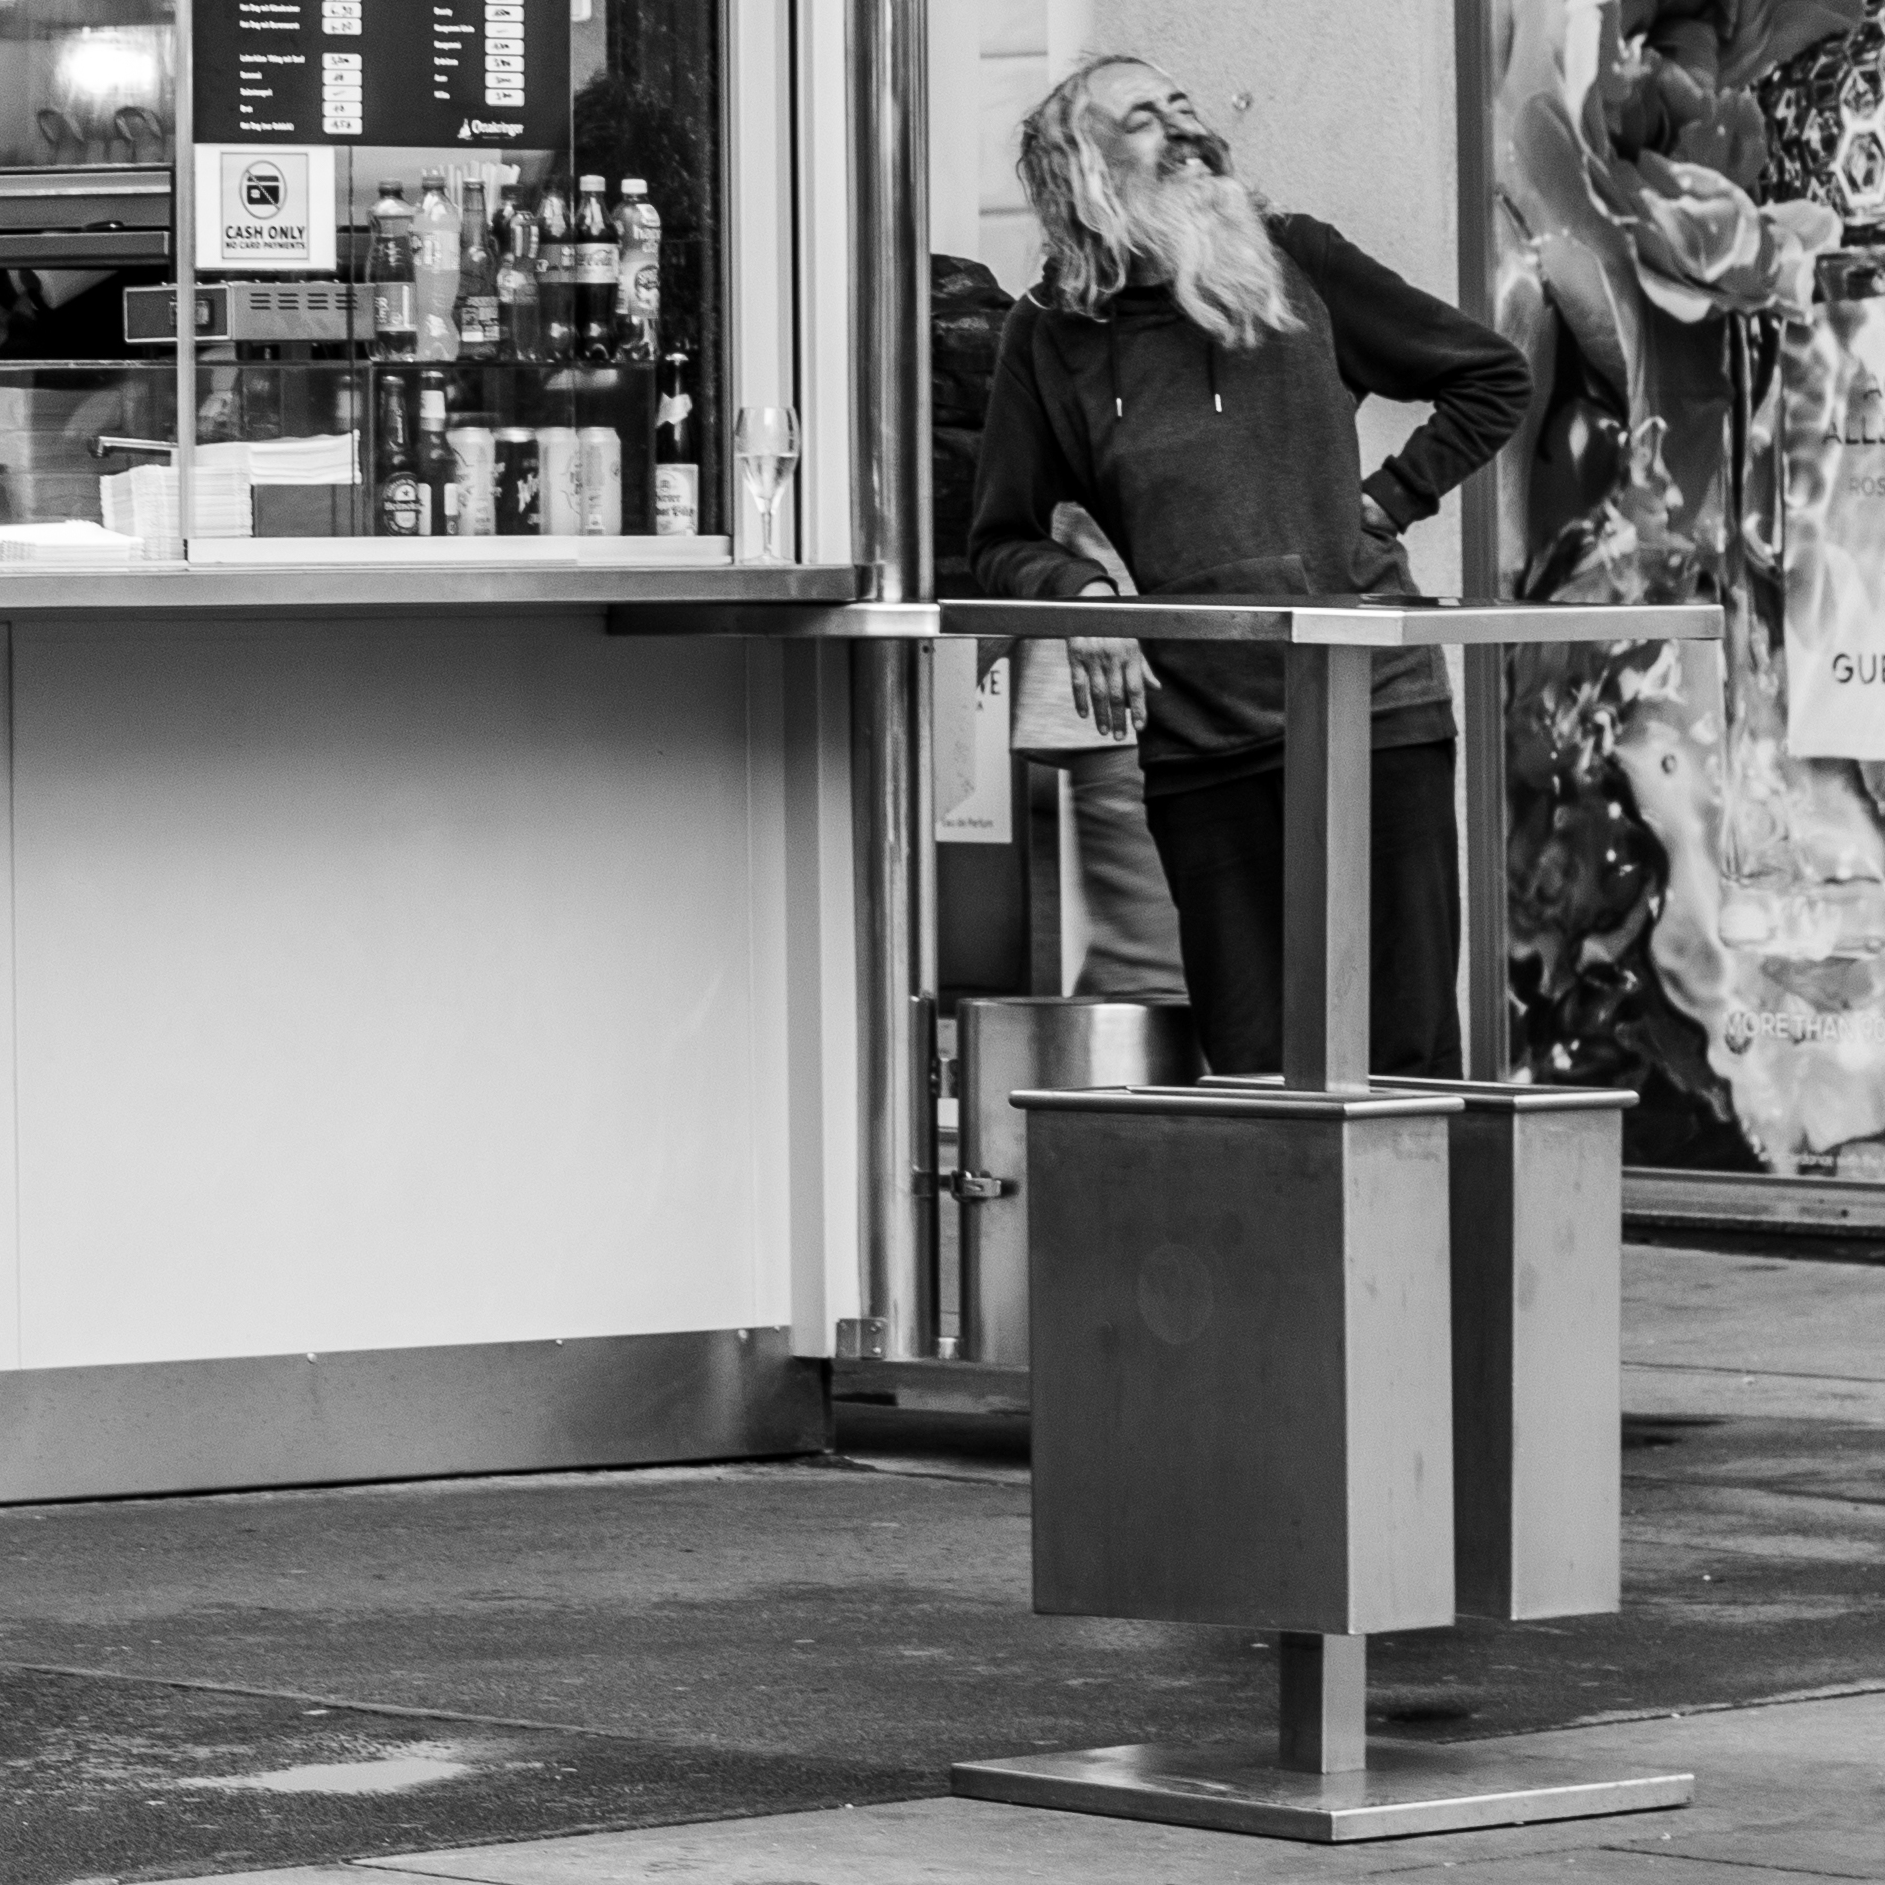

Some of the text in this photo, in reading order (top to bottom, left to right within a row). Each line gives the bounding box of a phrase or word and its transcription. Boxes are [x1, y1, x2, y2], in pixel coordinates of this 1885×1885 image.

[225, 225, 306, 240] CASH ONLY
[1831, 652, 1885, 686] GU
